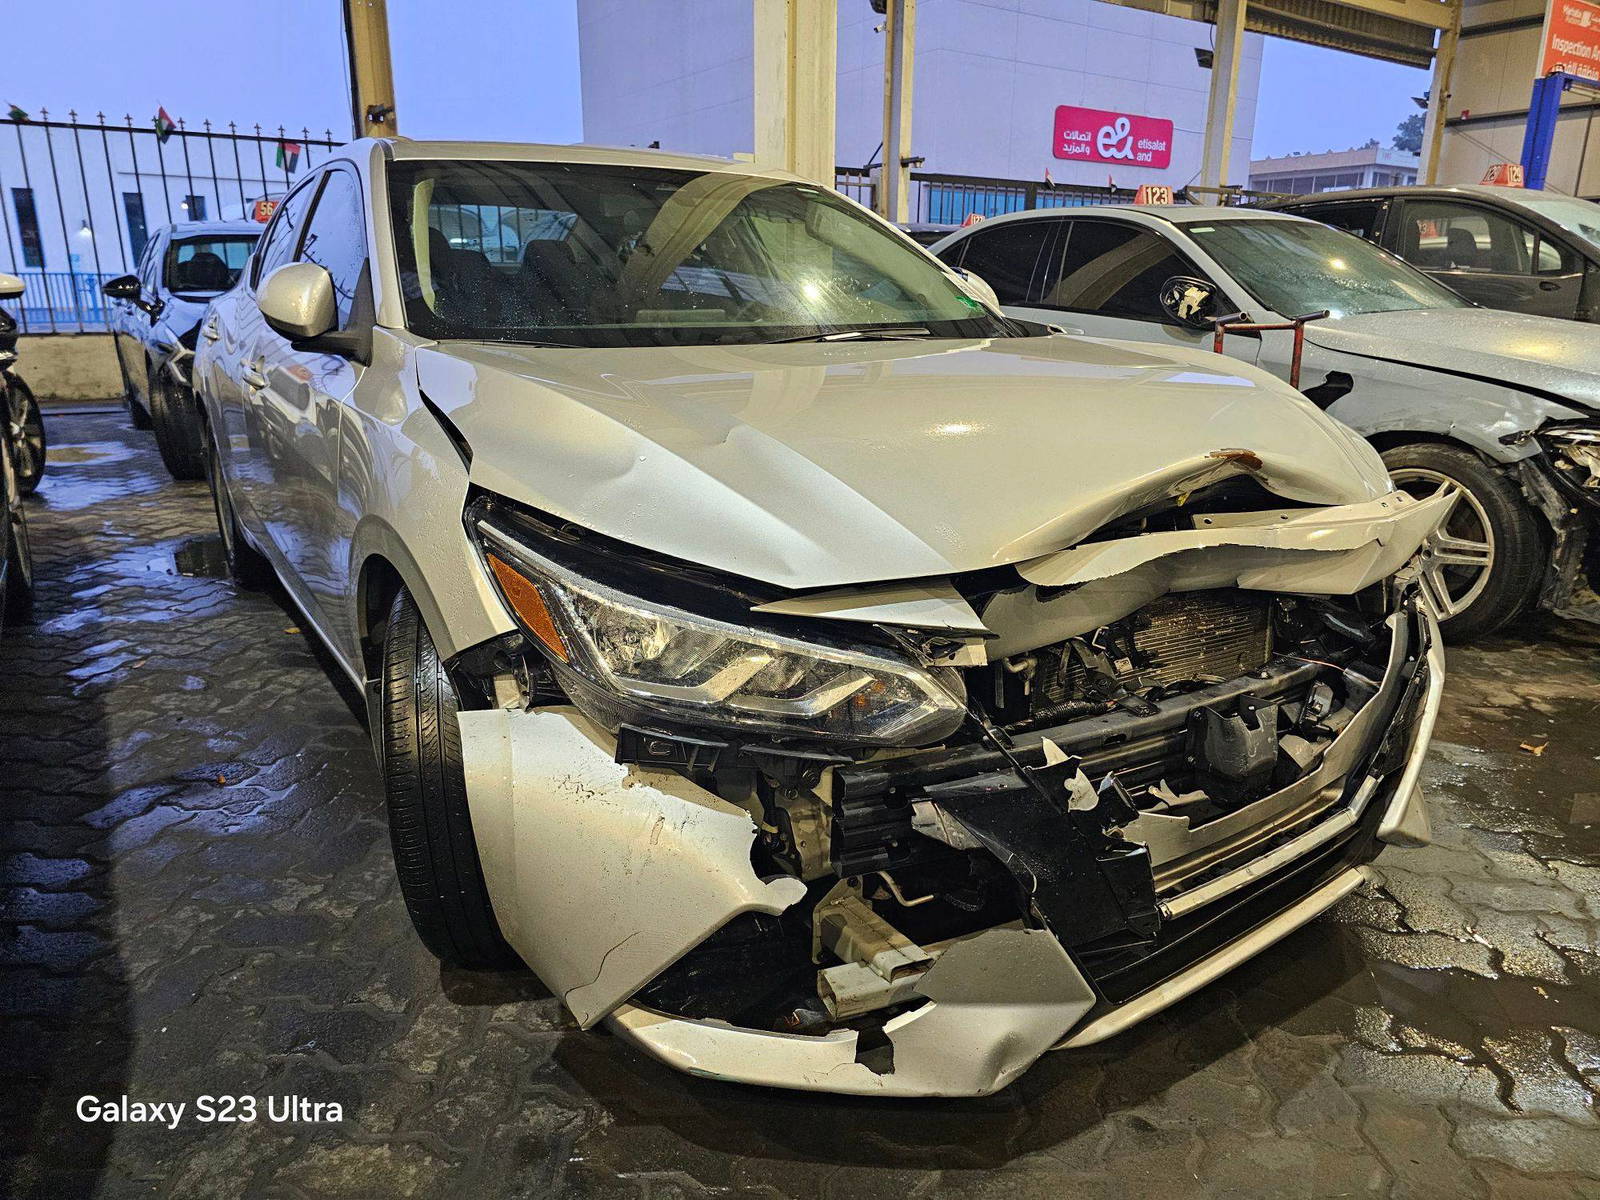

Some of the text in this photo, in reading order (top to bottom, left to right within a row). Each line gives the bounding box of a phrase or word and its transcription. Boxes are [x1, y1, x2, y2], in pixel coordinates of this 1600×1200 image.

[1552, 33, 1592, 59] Inspection
[1063, 130, 1092, 142] اتصالات
[1062, 142, 1091, 155] والمزيد
[1137, 138, 1167, 152] etisalat
[1136, 151, 1152, 162] and
[1146, 187, 1168, 205] 123
[260, 202, 273, 216] 56
